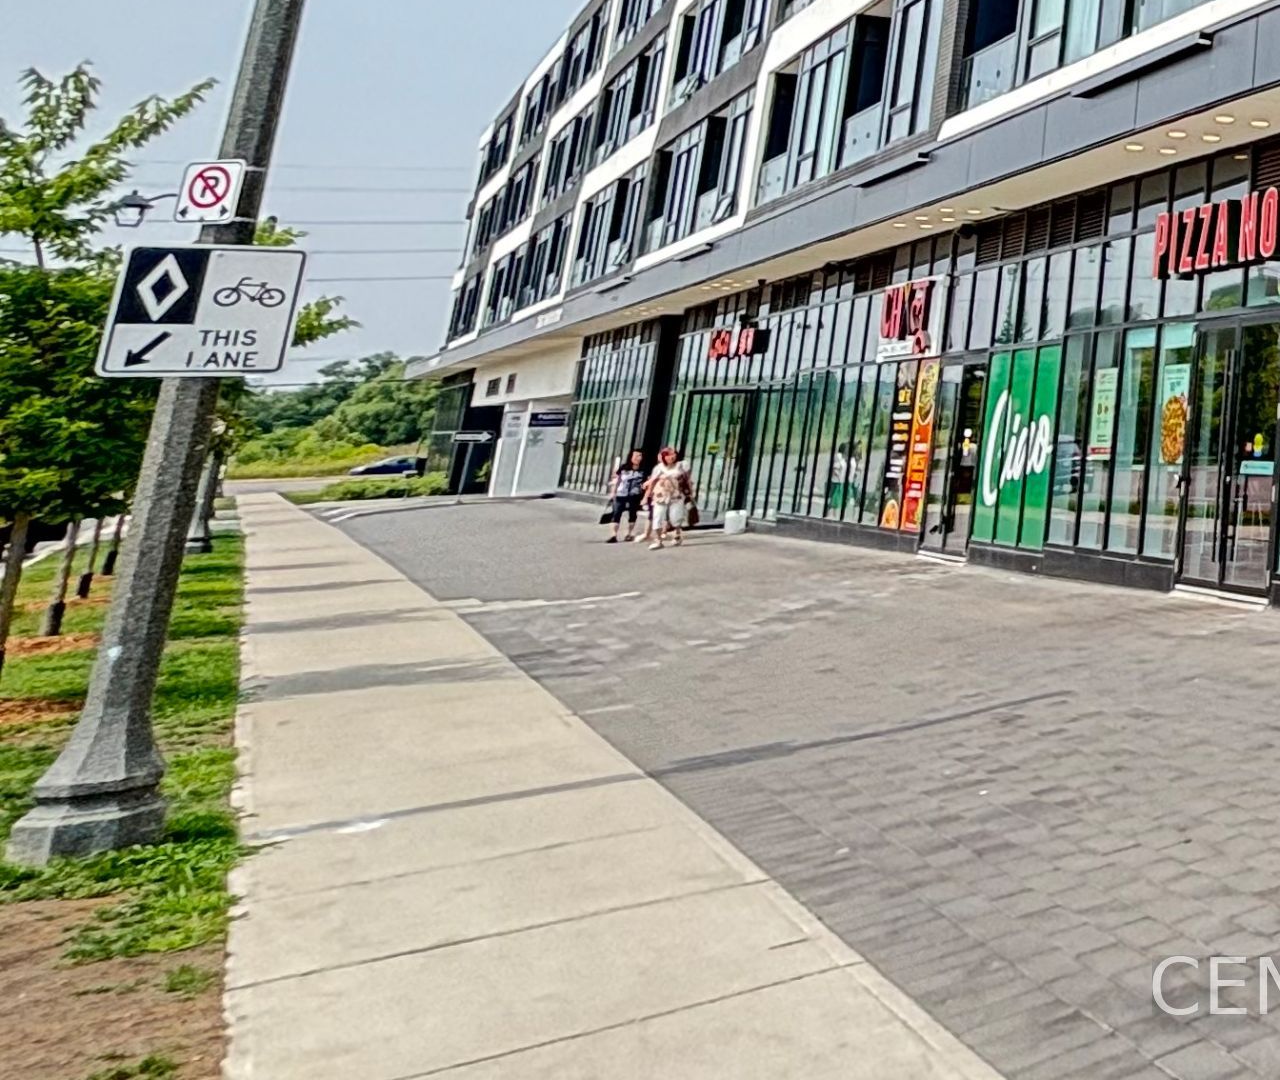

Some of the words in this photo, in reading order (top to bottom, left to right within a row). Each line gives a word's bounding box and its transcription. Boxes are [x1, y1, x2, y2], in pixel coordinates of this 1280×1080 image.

[1152, 199, 1228, 280] PIZZA
[186, 351, 259, 368] LANE
[200, 329, 258, 347] THIS
[982, 389, 1054, 507] Ciao
